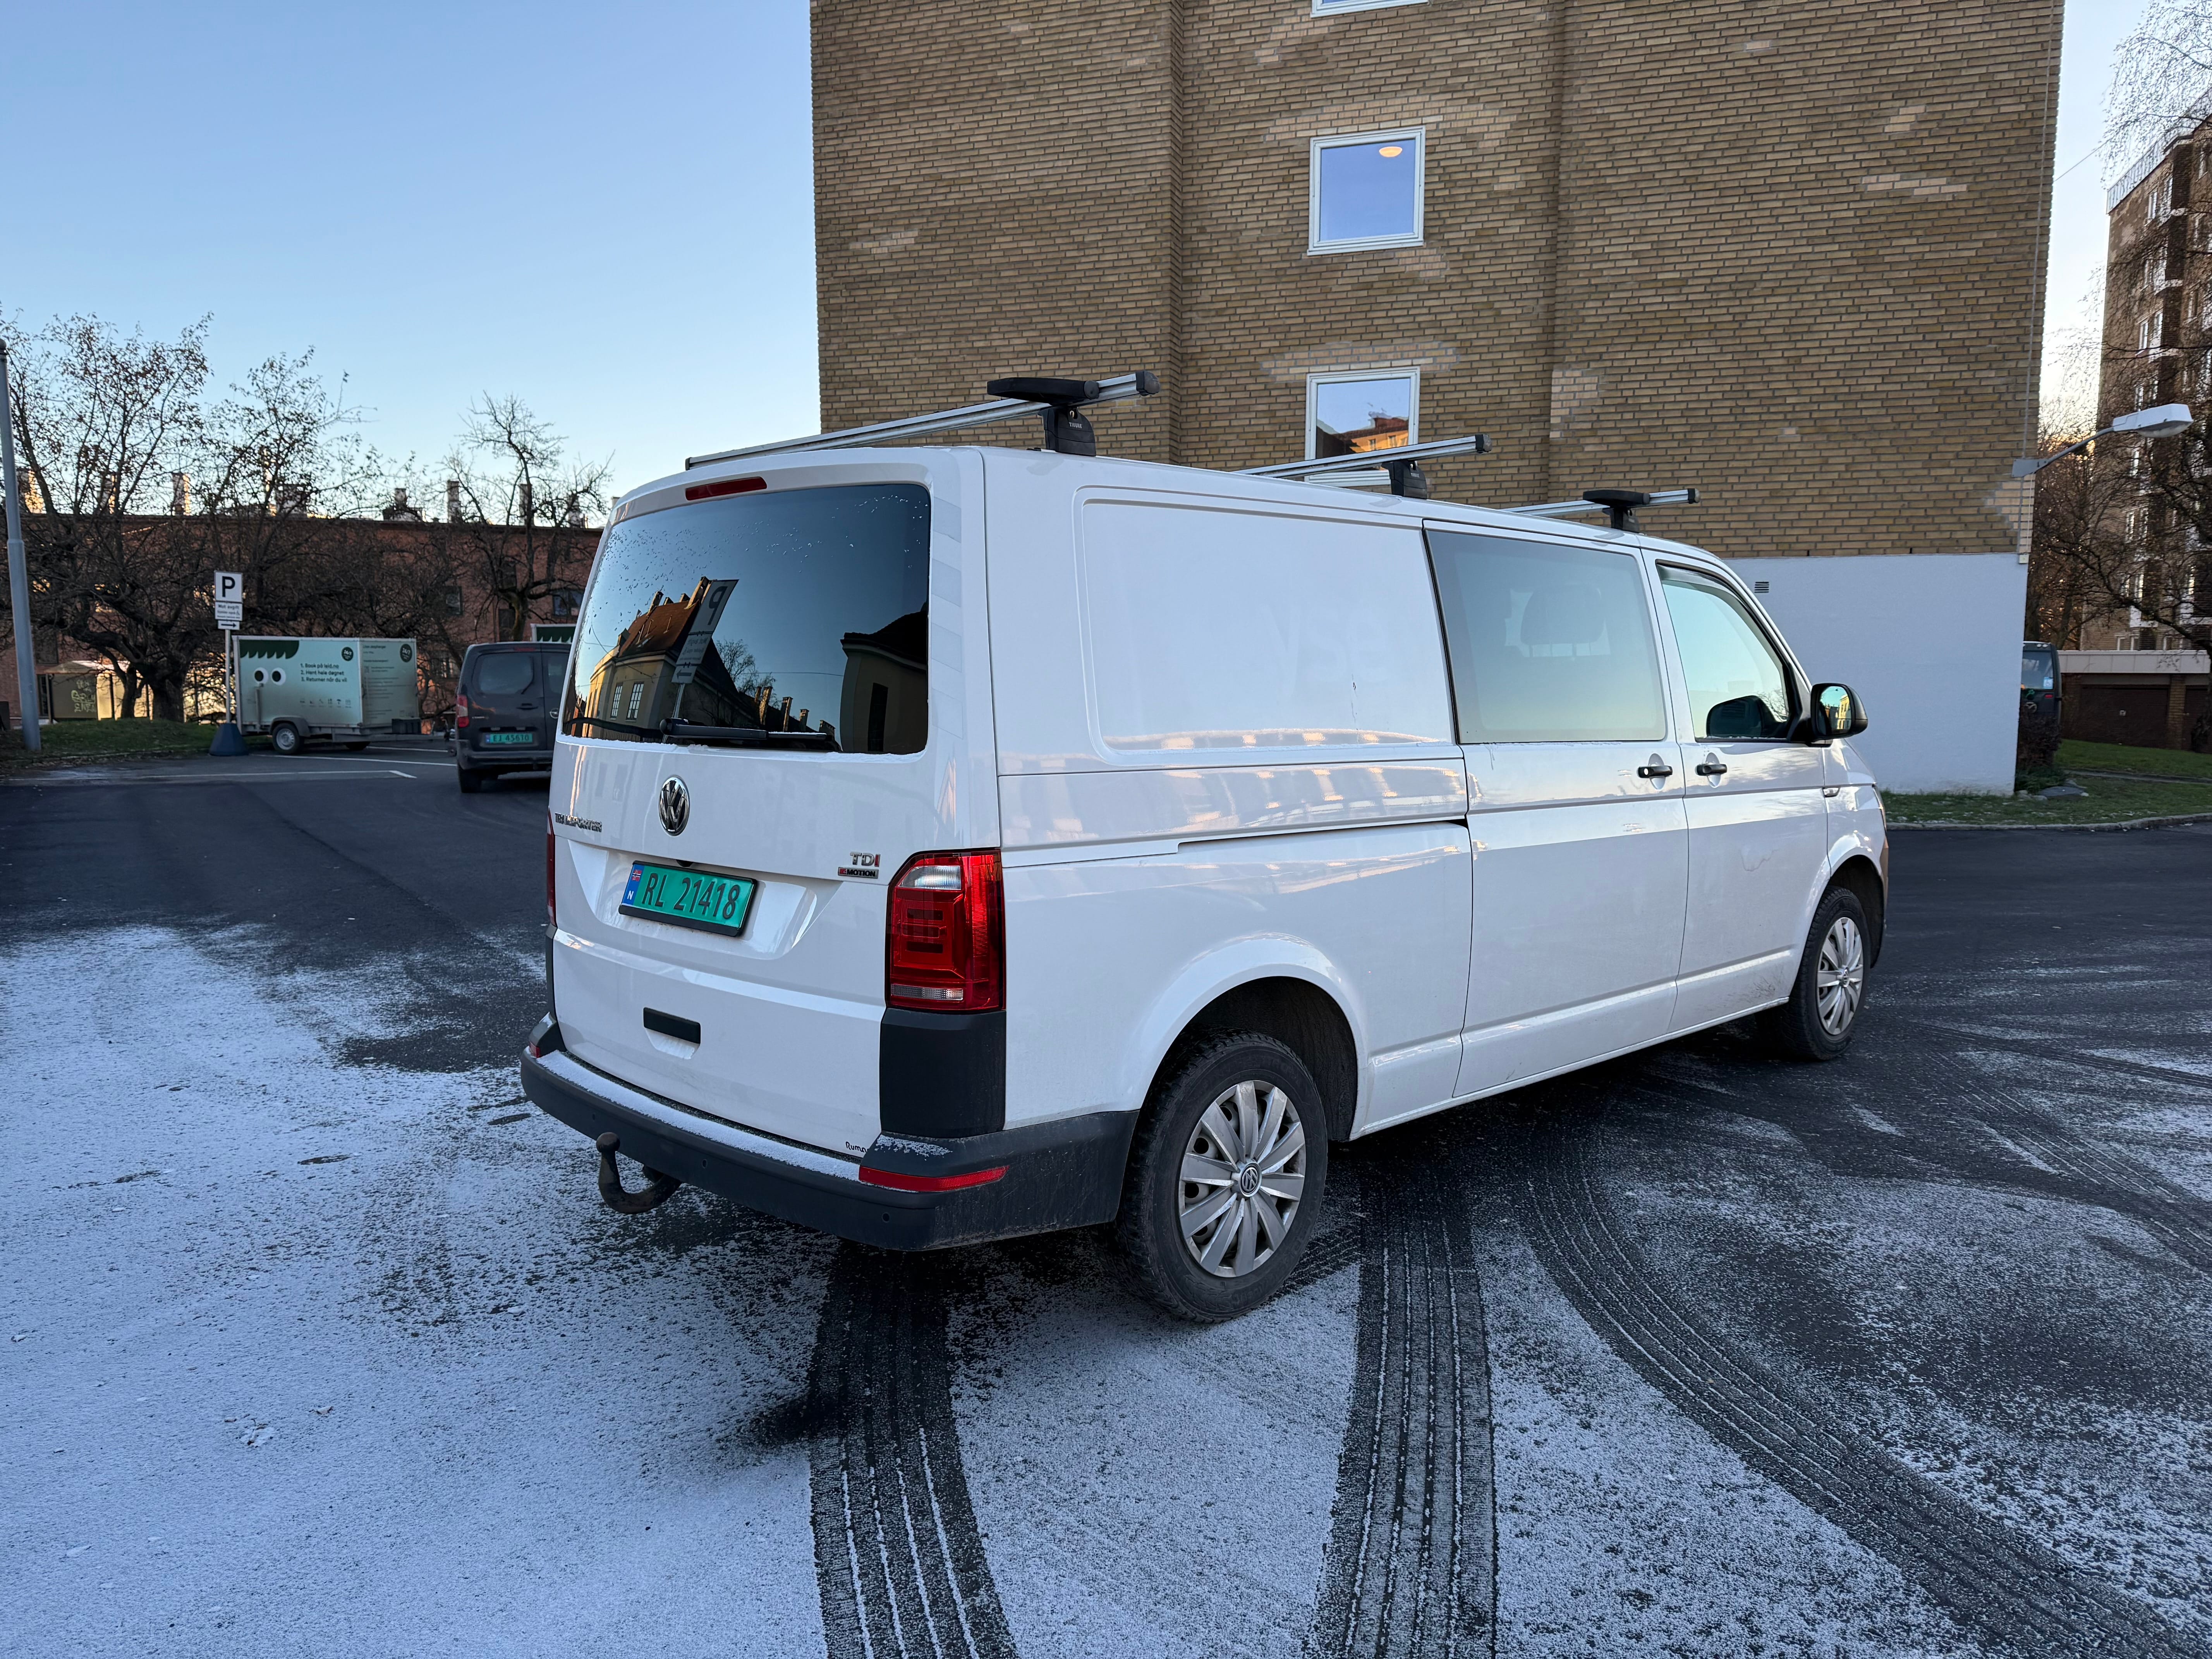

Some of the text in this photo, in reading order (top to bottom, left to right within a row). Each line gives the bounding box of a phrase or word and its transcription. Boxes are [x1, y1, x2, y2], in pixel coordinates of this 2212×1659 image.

[222, 576, 235, 597] P
[555, 812, 602, 833] TRANSPORTER
[850, 852, 881, 867] TDI
[627, 890, 634, 900] N
[641, 872, 740, 919] RL 21418
